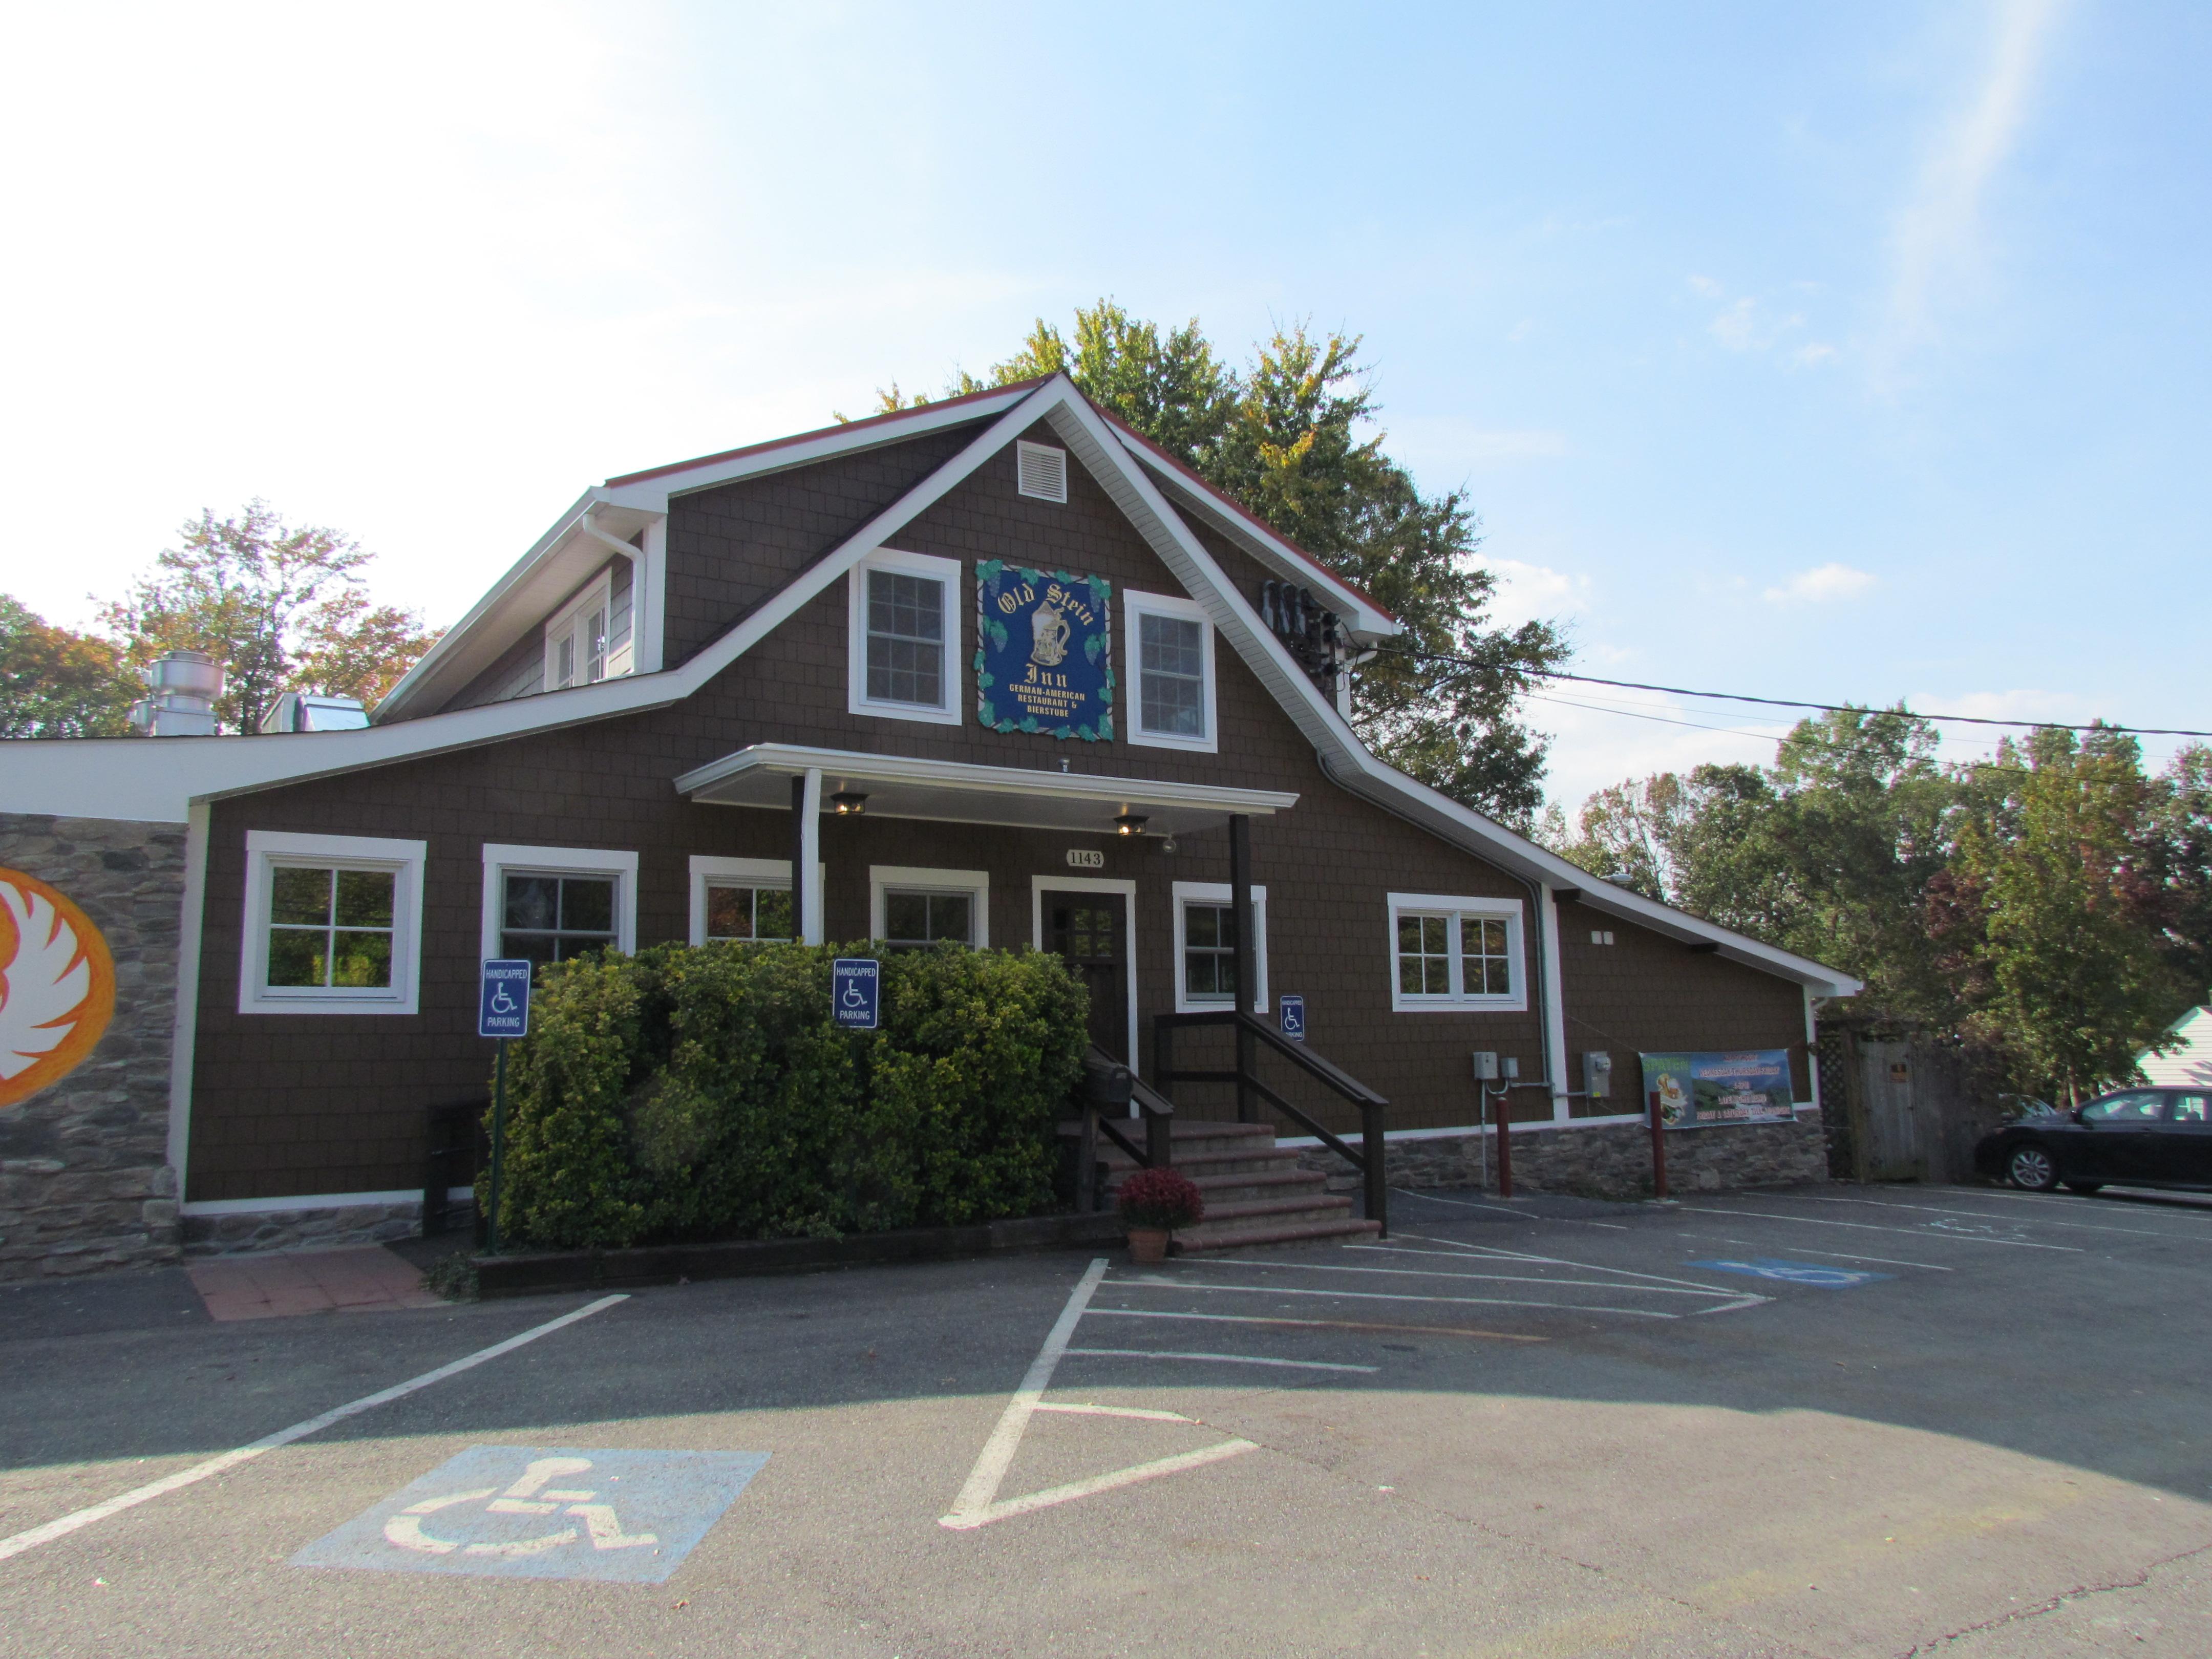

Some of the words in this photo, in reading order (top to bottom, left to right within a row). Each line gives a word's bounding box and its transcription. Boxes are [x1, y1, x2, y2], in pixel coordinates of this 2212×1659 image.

[998, 583, 1035, 613] Old
[1045, 584, 1094, 626] Stein
[1024, 663, 1067, 688] Inn
[1009, 684, 1085, 701] GERMAN-AMERICAN
[1018, 694, 1068, 708] RESTAURANT
[1027, 705, 1069, 717] BIERSTUBE
[1071, 852, 1100, 865] 1143
[486, 969, 527, 979] HANDICAPPED
[836, 967, 876, 976] HANDICAPPED
[840, 1010, 870, 1020] PARKING
[487, 1017, 520, 1027] PARKING
